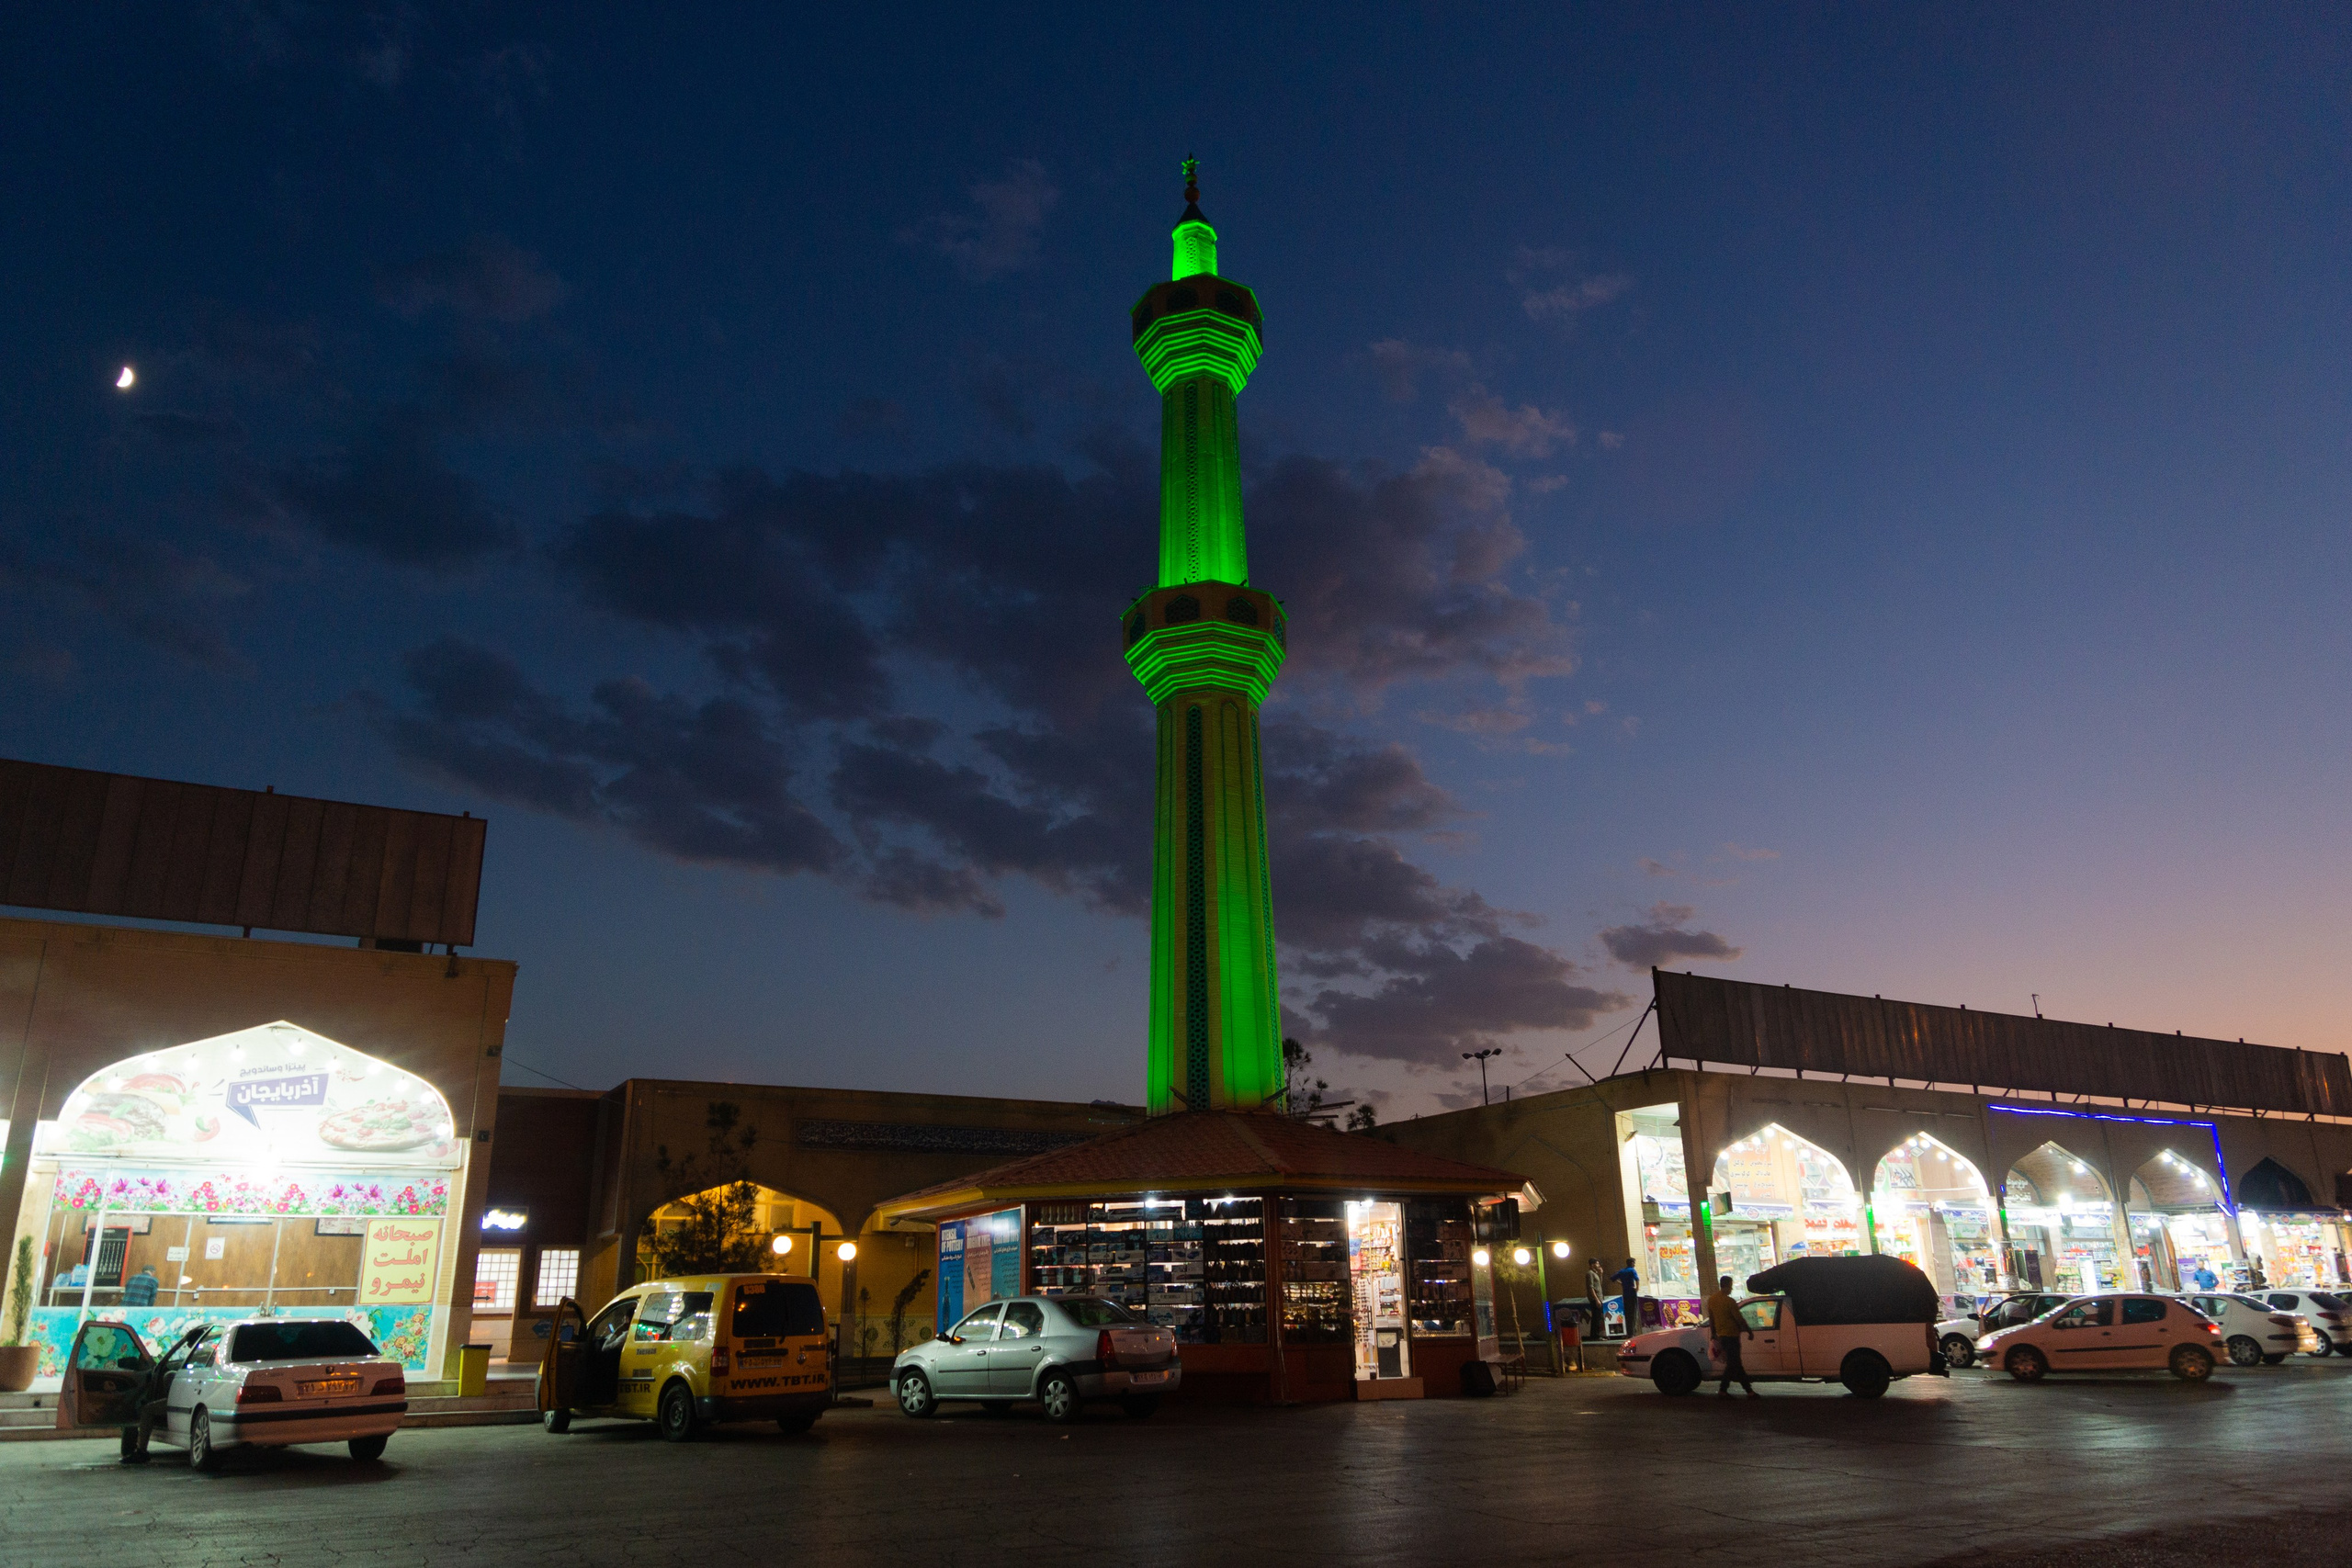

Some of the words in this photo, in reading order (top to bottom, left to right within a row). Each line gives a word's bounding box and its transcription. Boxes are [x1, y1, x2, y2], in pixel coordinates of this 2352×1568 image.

[236, 1077, 320, 1104] آذربایجان
[373, 1224, 434, 1247] صبحانه
[373, 1248, 429, 1267] املت
[368, 1273, 425, 1297] نیمرو
